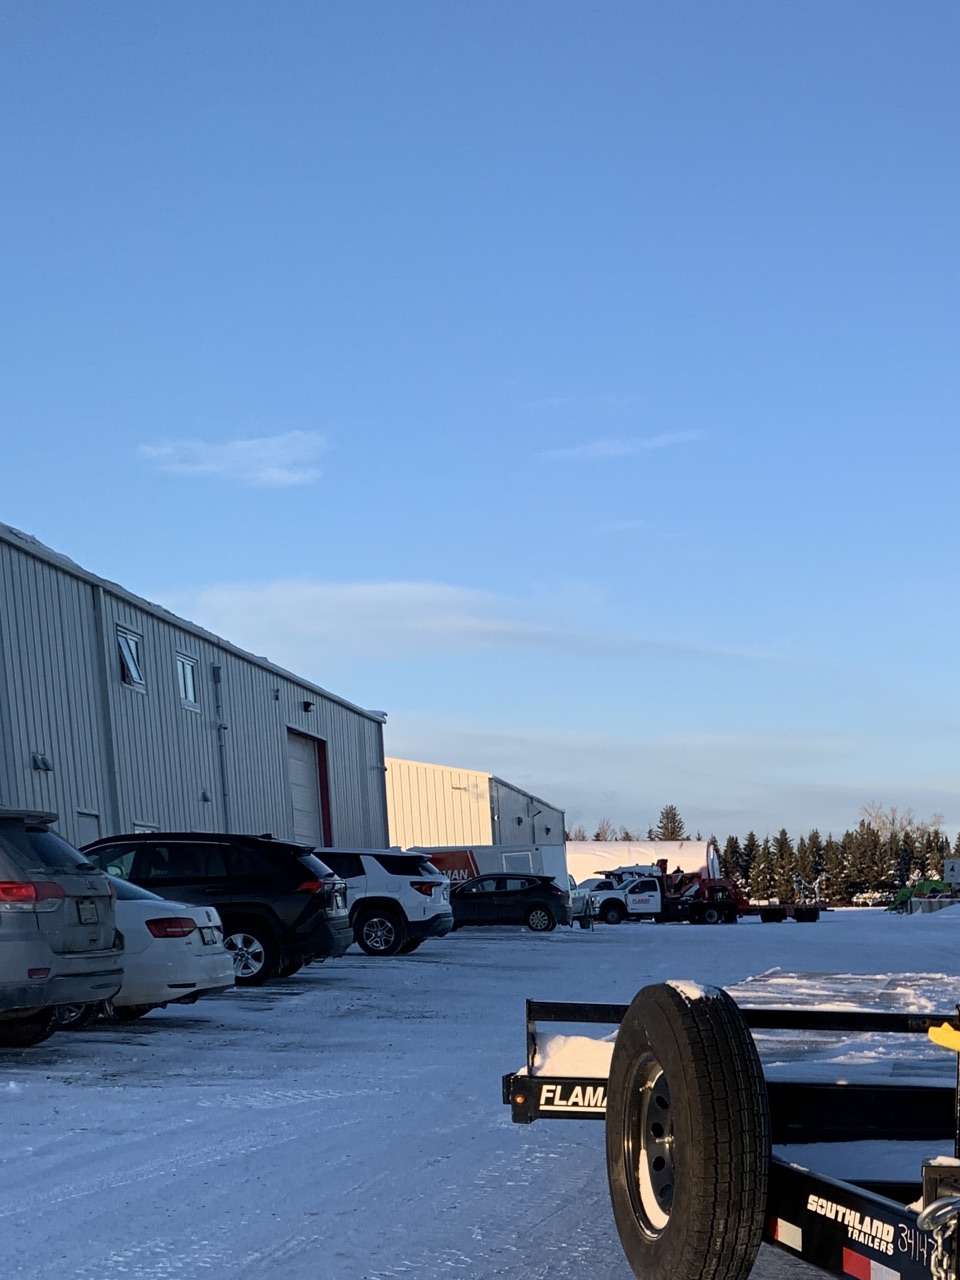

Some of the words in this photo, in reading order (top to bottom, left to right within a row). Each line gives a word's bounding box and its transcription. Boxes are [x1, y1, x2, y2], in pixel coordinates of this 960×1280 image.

[539, 1084, 607, 1107] FLAM
[806, 1193, 895, 1243] SOUTHLAND
[847, 1226, 894, 1256] TRAILERS
